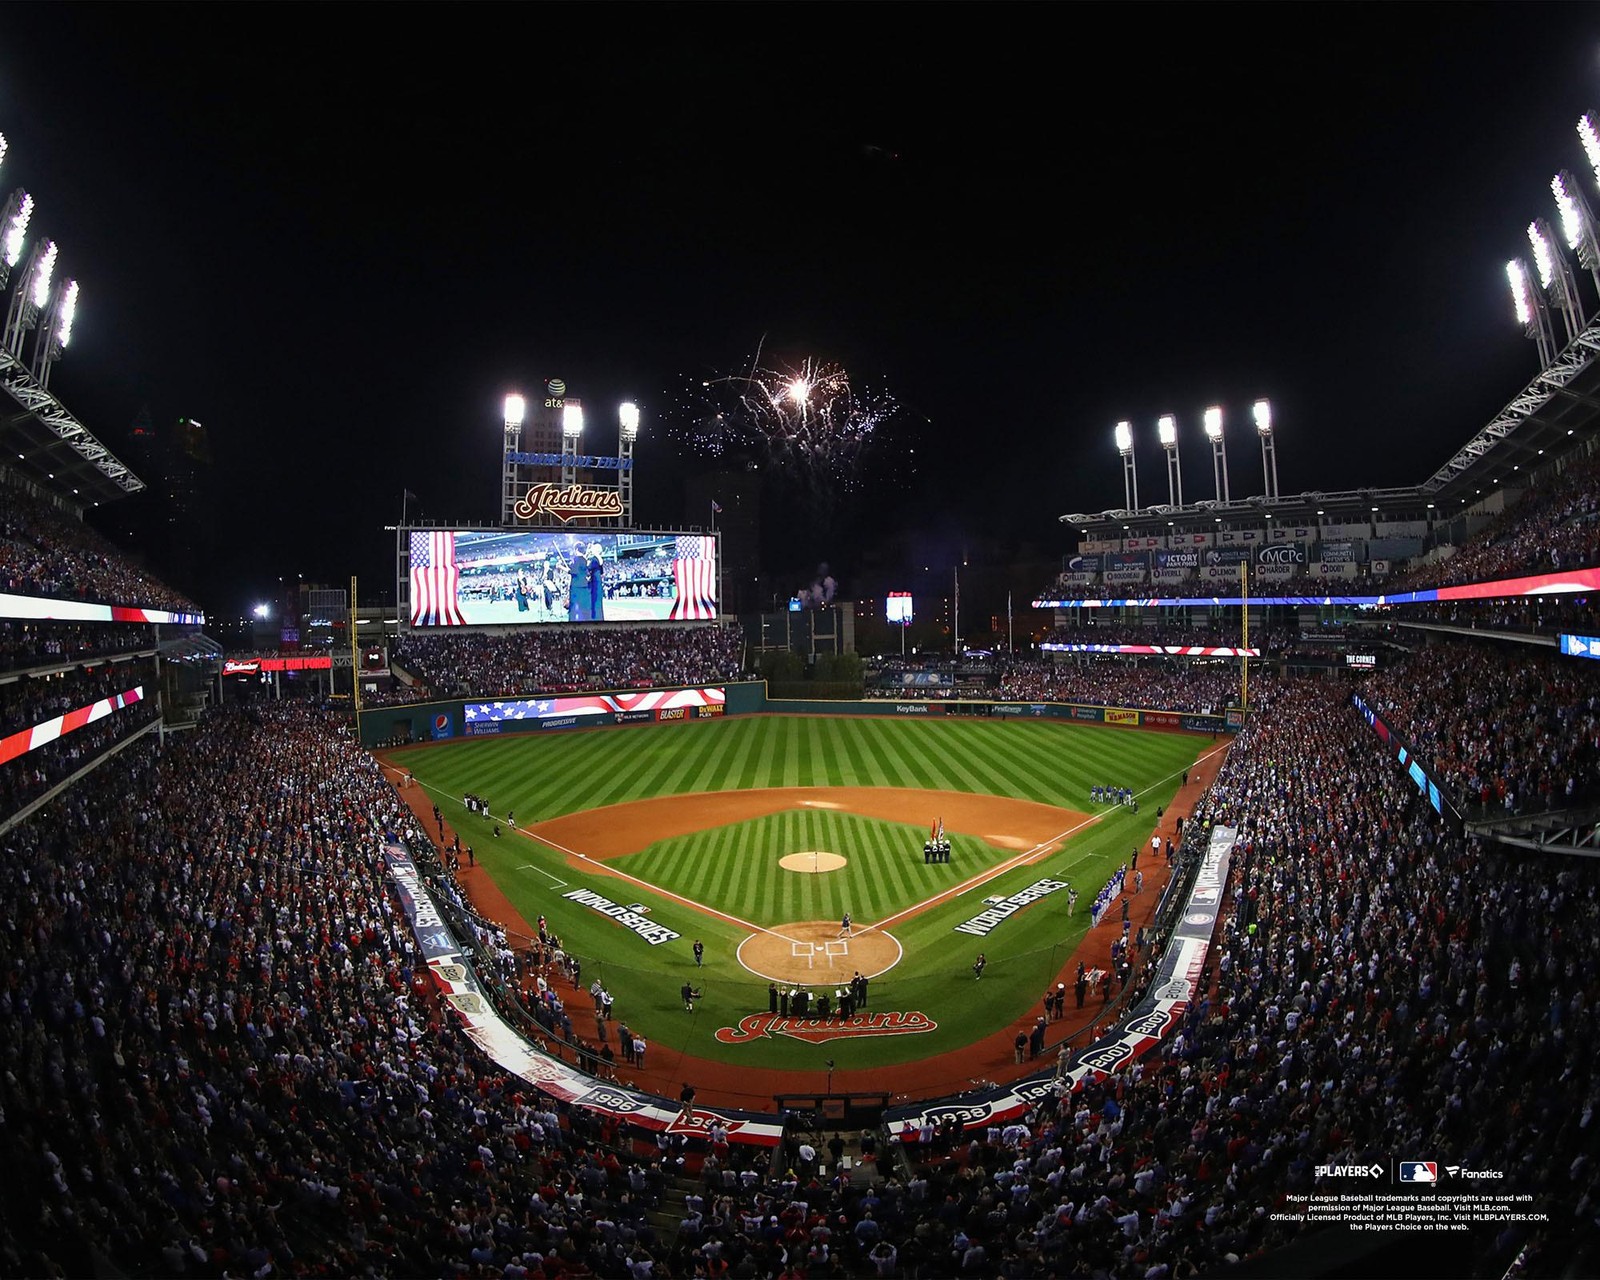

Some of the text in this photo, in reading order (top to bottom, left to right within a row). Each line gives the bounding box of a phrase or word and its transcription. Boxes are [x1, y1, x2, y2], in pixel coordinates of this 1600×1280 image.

[545, 398, 565, 408] at&
[514, 483, 624, 523] Indians
[1345, 654, 1376, 665] THE CORNER
[896, 705, 928, 713] KeyBank
[541, 717, 576, 728] PROGRESSIVE
[562, 888, 681, 945] WORLD SERIES
[954, 878, 1069, 936] WORLD SERIES
[714, 1010, 938, 1044] Indians
[1135, 1012, 1168, 1033] 2007
[1091, 1045, 1130, 1066] 2001
[587, 1090, 637, 1112] 1996
